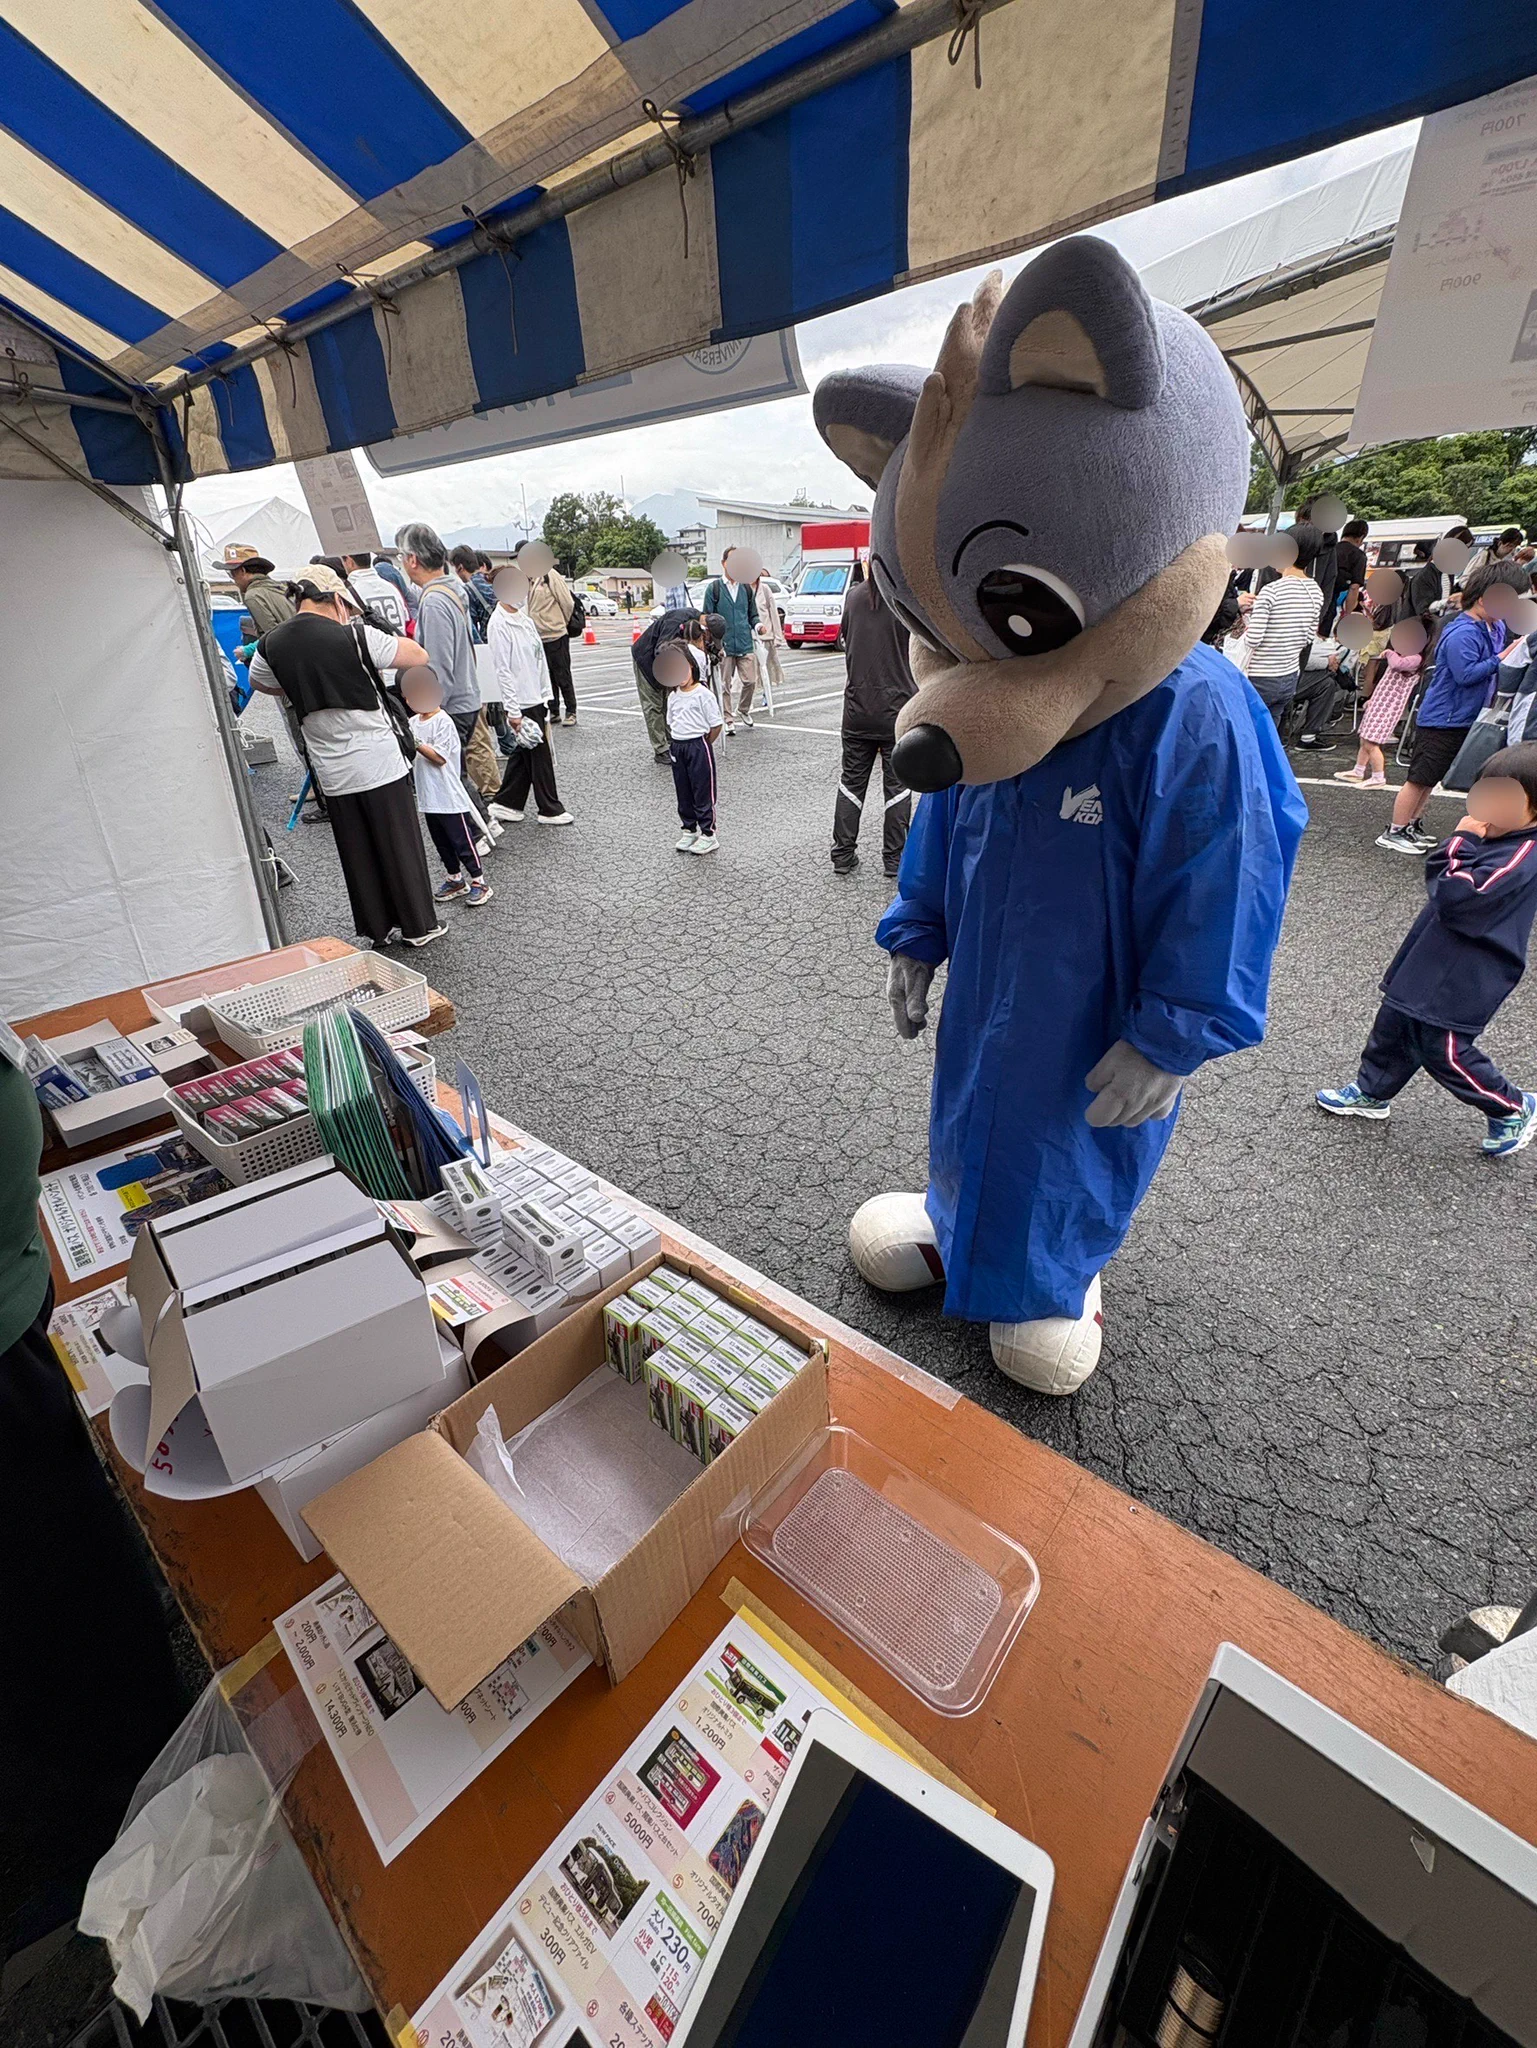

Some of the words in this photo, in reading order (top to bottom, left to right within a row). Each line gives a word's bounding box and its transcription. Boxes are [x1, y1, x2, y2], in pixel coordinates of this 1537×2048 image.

[299, 1620, 317, 1644] 200円
[293, 1638, 315, 1670] 2,000円
[322, 1699, 347, 1738] 14,300円
[456, 1699, 477, 1724] 00円
[700, 1705, 734, 1740] オリジナルトミカ
[623, 1811, 654, 1849] 5000円
[558, 1882, 599, 1934] おひとり様3枚まで
[535, 1893, 592, 1969] デビュー記念クリアファイル
[540, 1927, 566, 1965] 300円
[572, 1925, 598, 1954] エルガEV
